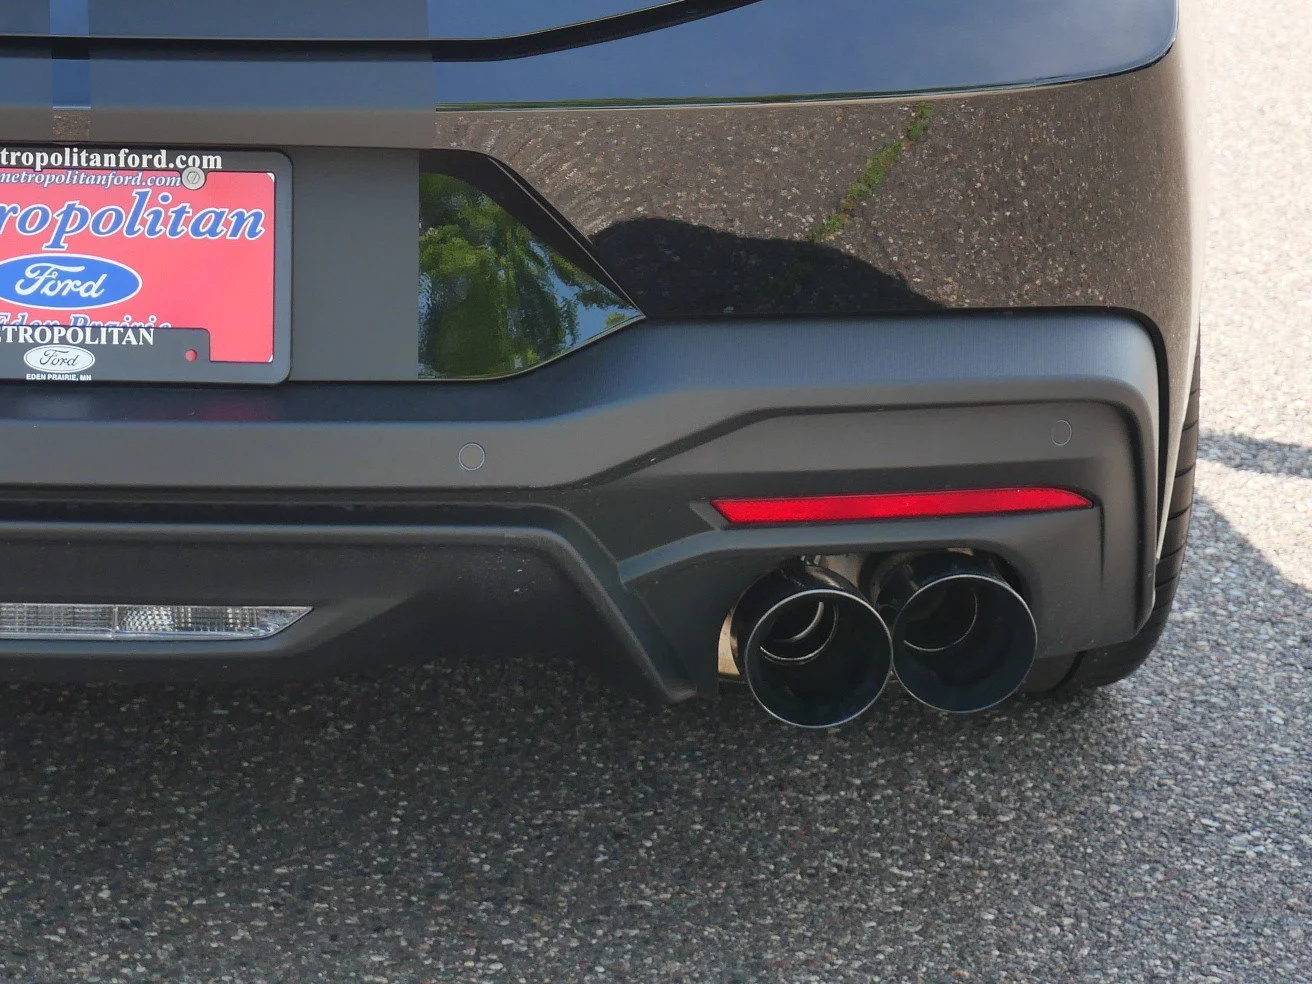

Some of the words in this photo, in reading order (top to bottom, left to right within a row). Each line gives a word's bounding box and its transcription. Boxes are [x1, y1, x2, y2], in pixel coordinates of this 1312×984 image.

[15, 262, 106, 299] Ford
[39, 349, 79, 367] Ford
[26, 373, 46, 381] EDEN
[47, 373, 79, 382] PRAIRIE,
[80, 374, 92, 382] MN
